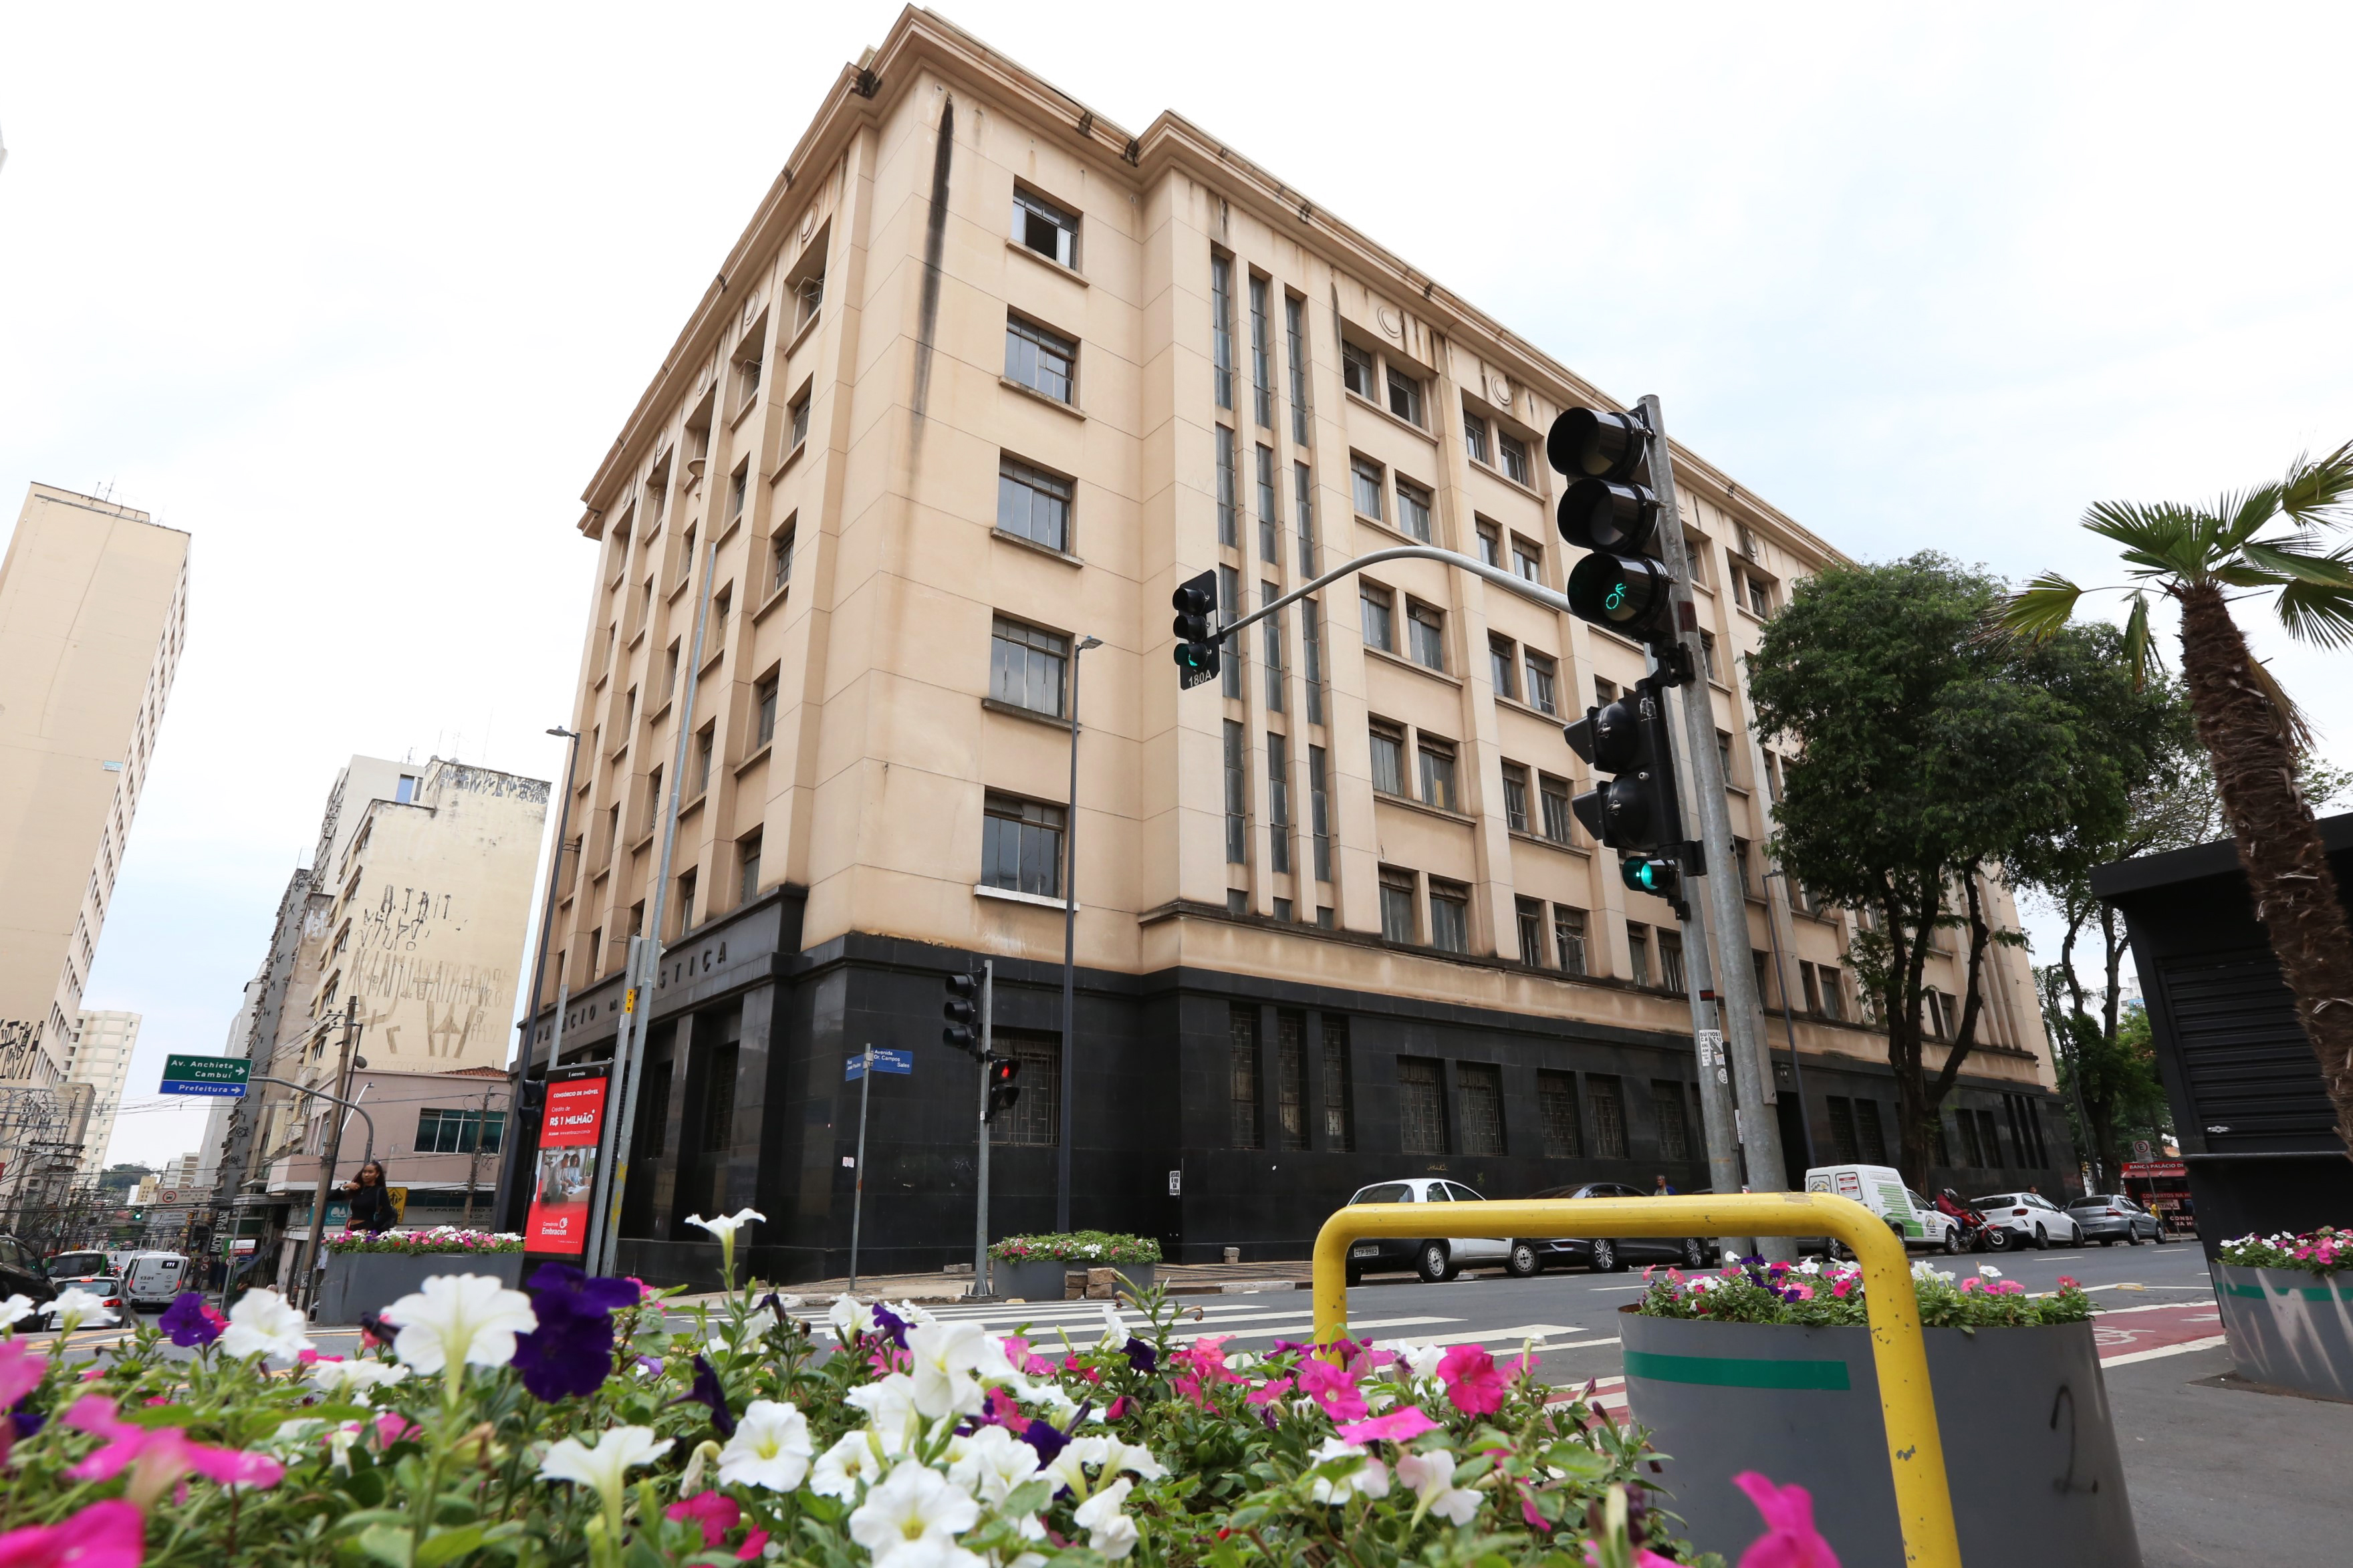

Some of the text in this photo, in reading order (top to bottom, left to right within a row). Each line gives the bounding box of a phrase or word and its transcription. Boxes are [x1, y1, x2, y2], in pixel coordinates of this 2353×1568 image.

[1189, 669, 1212, 687] 180A
[537, 1002, 597, 1044] PAÁCIO
[634, 941, 727, 1001] JSTIÇA
[190, 1061, 233, 1069] Anchieta
[195, 1071, 232, 1079] Cambuí
[178, 1085, 228, 1093] Prefeitura
[549, 1116, 559, 1127] R$
[560, 1116, 564, 1126] 1
[541, 1227, 567, 1235] Embracon
